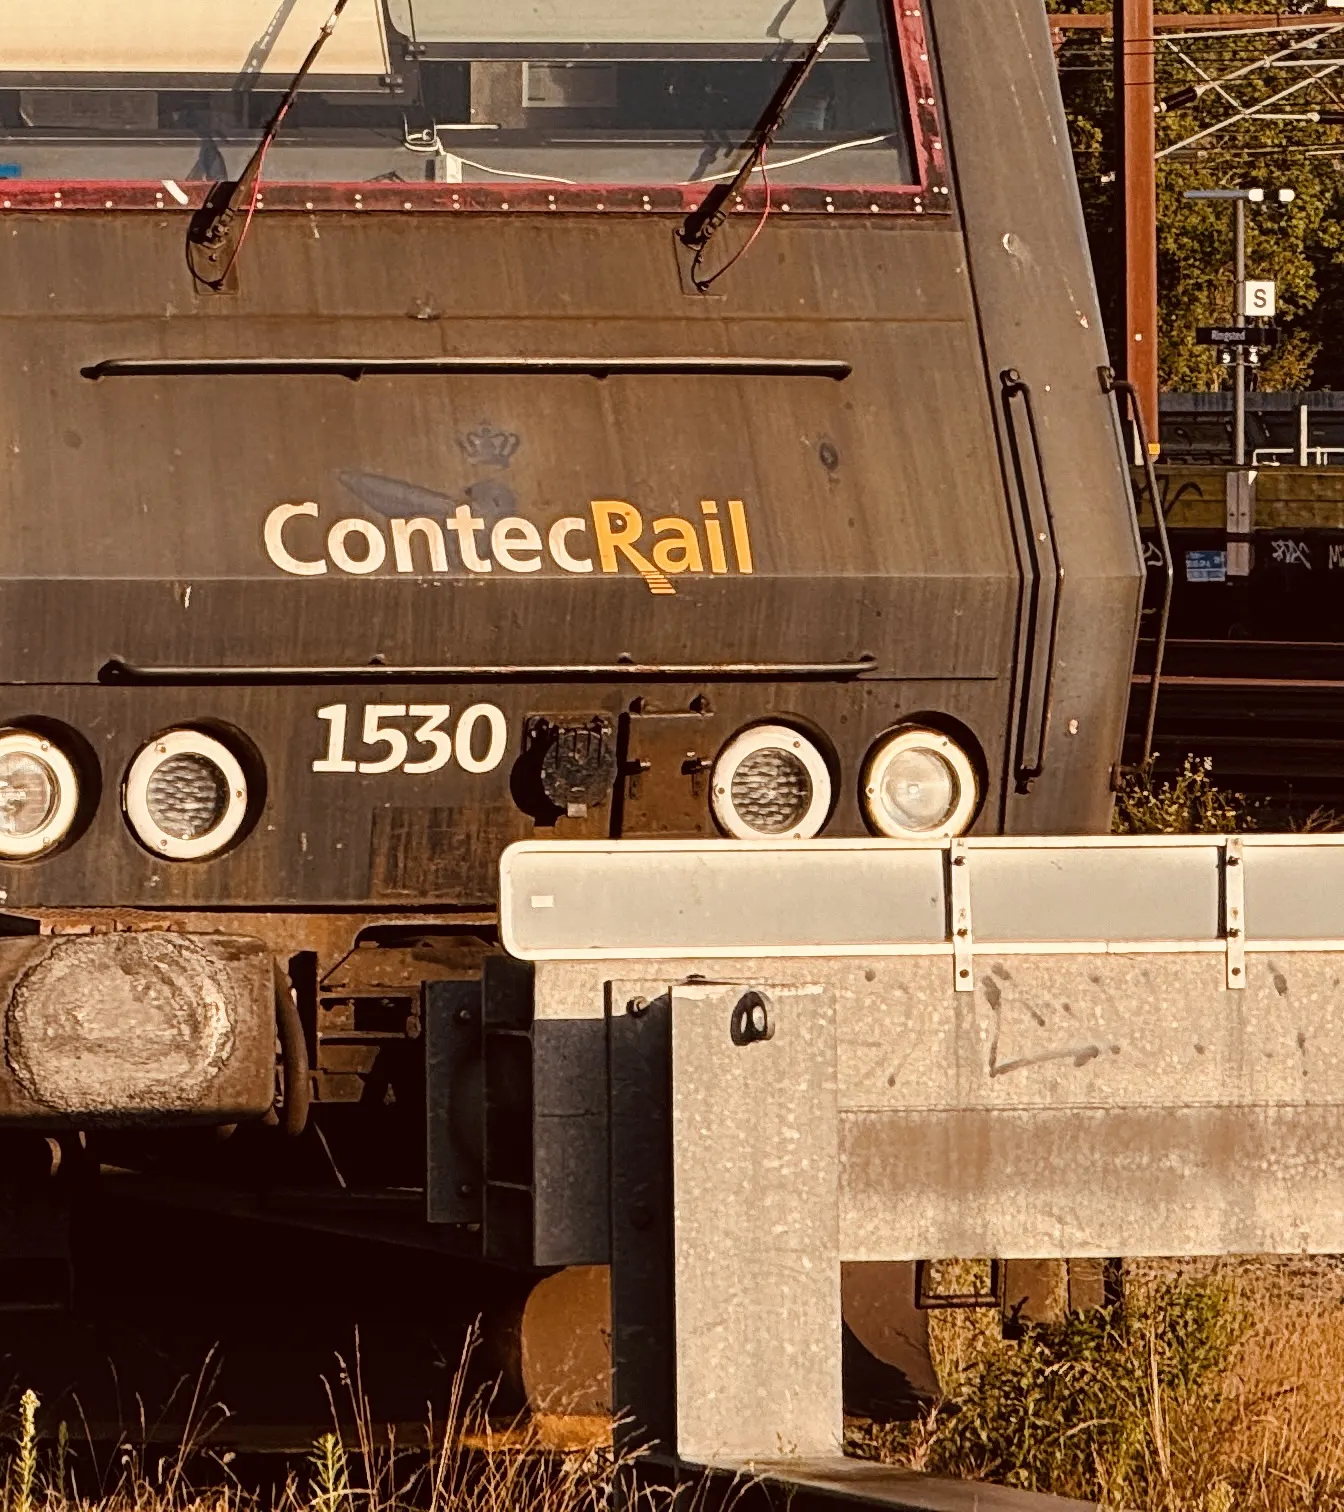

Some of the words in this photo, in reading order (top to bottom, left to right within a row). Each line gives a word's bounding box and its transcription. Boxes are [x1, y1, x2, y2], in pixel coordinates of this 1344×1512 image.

[1253, 289, 1267, 308] S
[1211, 330, 1246, 342] Ringsted
[263, 499, 754, 594] ContecRail
[312, 702, 508, 775] 1530
